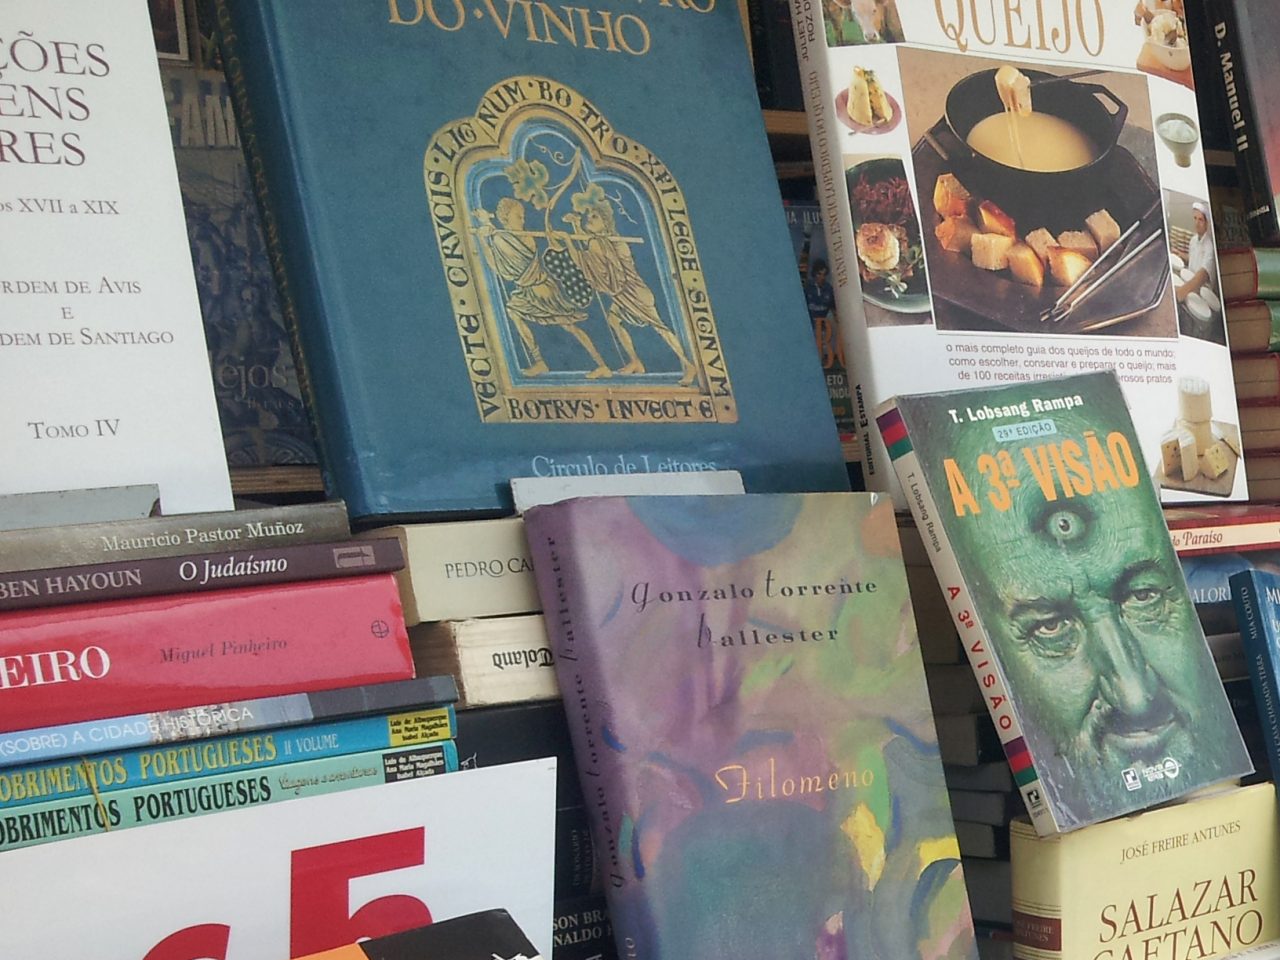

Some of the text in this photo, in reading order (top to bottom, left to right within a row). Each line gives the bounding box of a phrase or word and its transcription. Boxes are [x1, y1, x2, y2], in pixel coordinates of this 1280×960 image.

[1212, 22, 1249, 153] D. Manuel II
[20, 199, 120, 215] XVII a XIX
[61, 306, 74, 320] E
[946, 344, 952, 352] o
[955, 344, 978, 353] mais
[981, 344, 1024, 355] completo
[1027, 346, 1046, 355] guia
[1049, 346, 1065, 355] dos
[1067, 347, 1099, 357] queijos
[1102, 348, 1113, 356] de
[1115, 348, 1134, 357] todo
[948, 393, 1083, 424] T. Lobsang Rampa
[96, 419, 120, 437] IV
[944, 457, 981, 517] A
[1024, 429, 1139, 502] VISÃO
[103, 521, 304, 552] Mauricio Pastor Muñoz
[45, 569, 142, 595] HAYOUN
[179, 555, 288, 586] O Judaísmo
[446, 560, 504, 579] PEDRO
[135, 775, 271, 823] PORTUGUESES
[1121, 820, 1241, 864] JOSÉ FREIRE ANTUNES
[1099, 868, 1258, 943] SALAZAR
